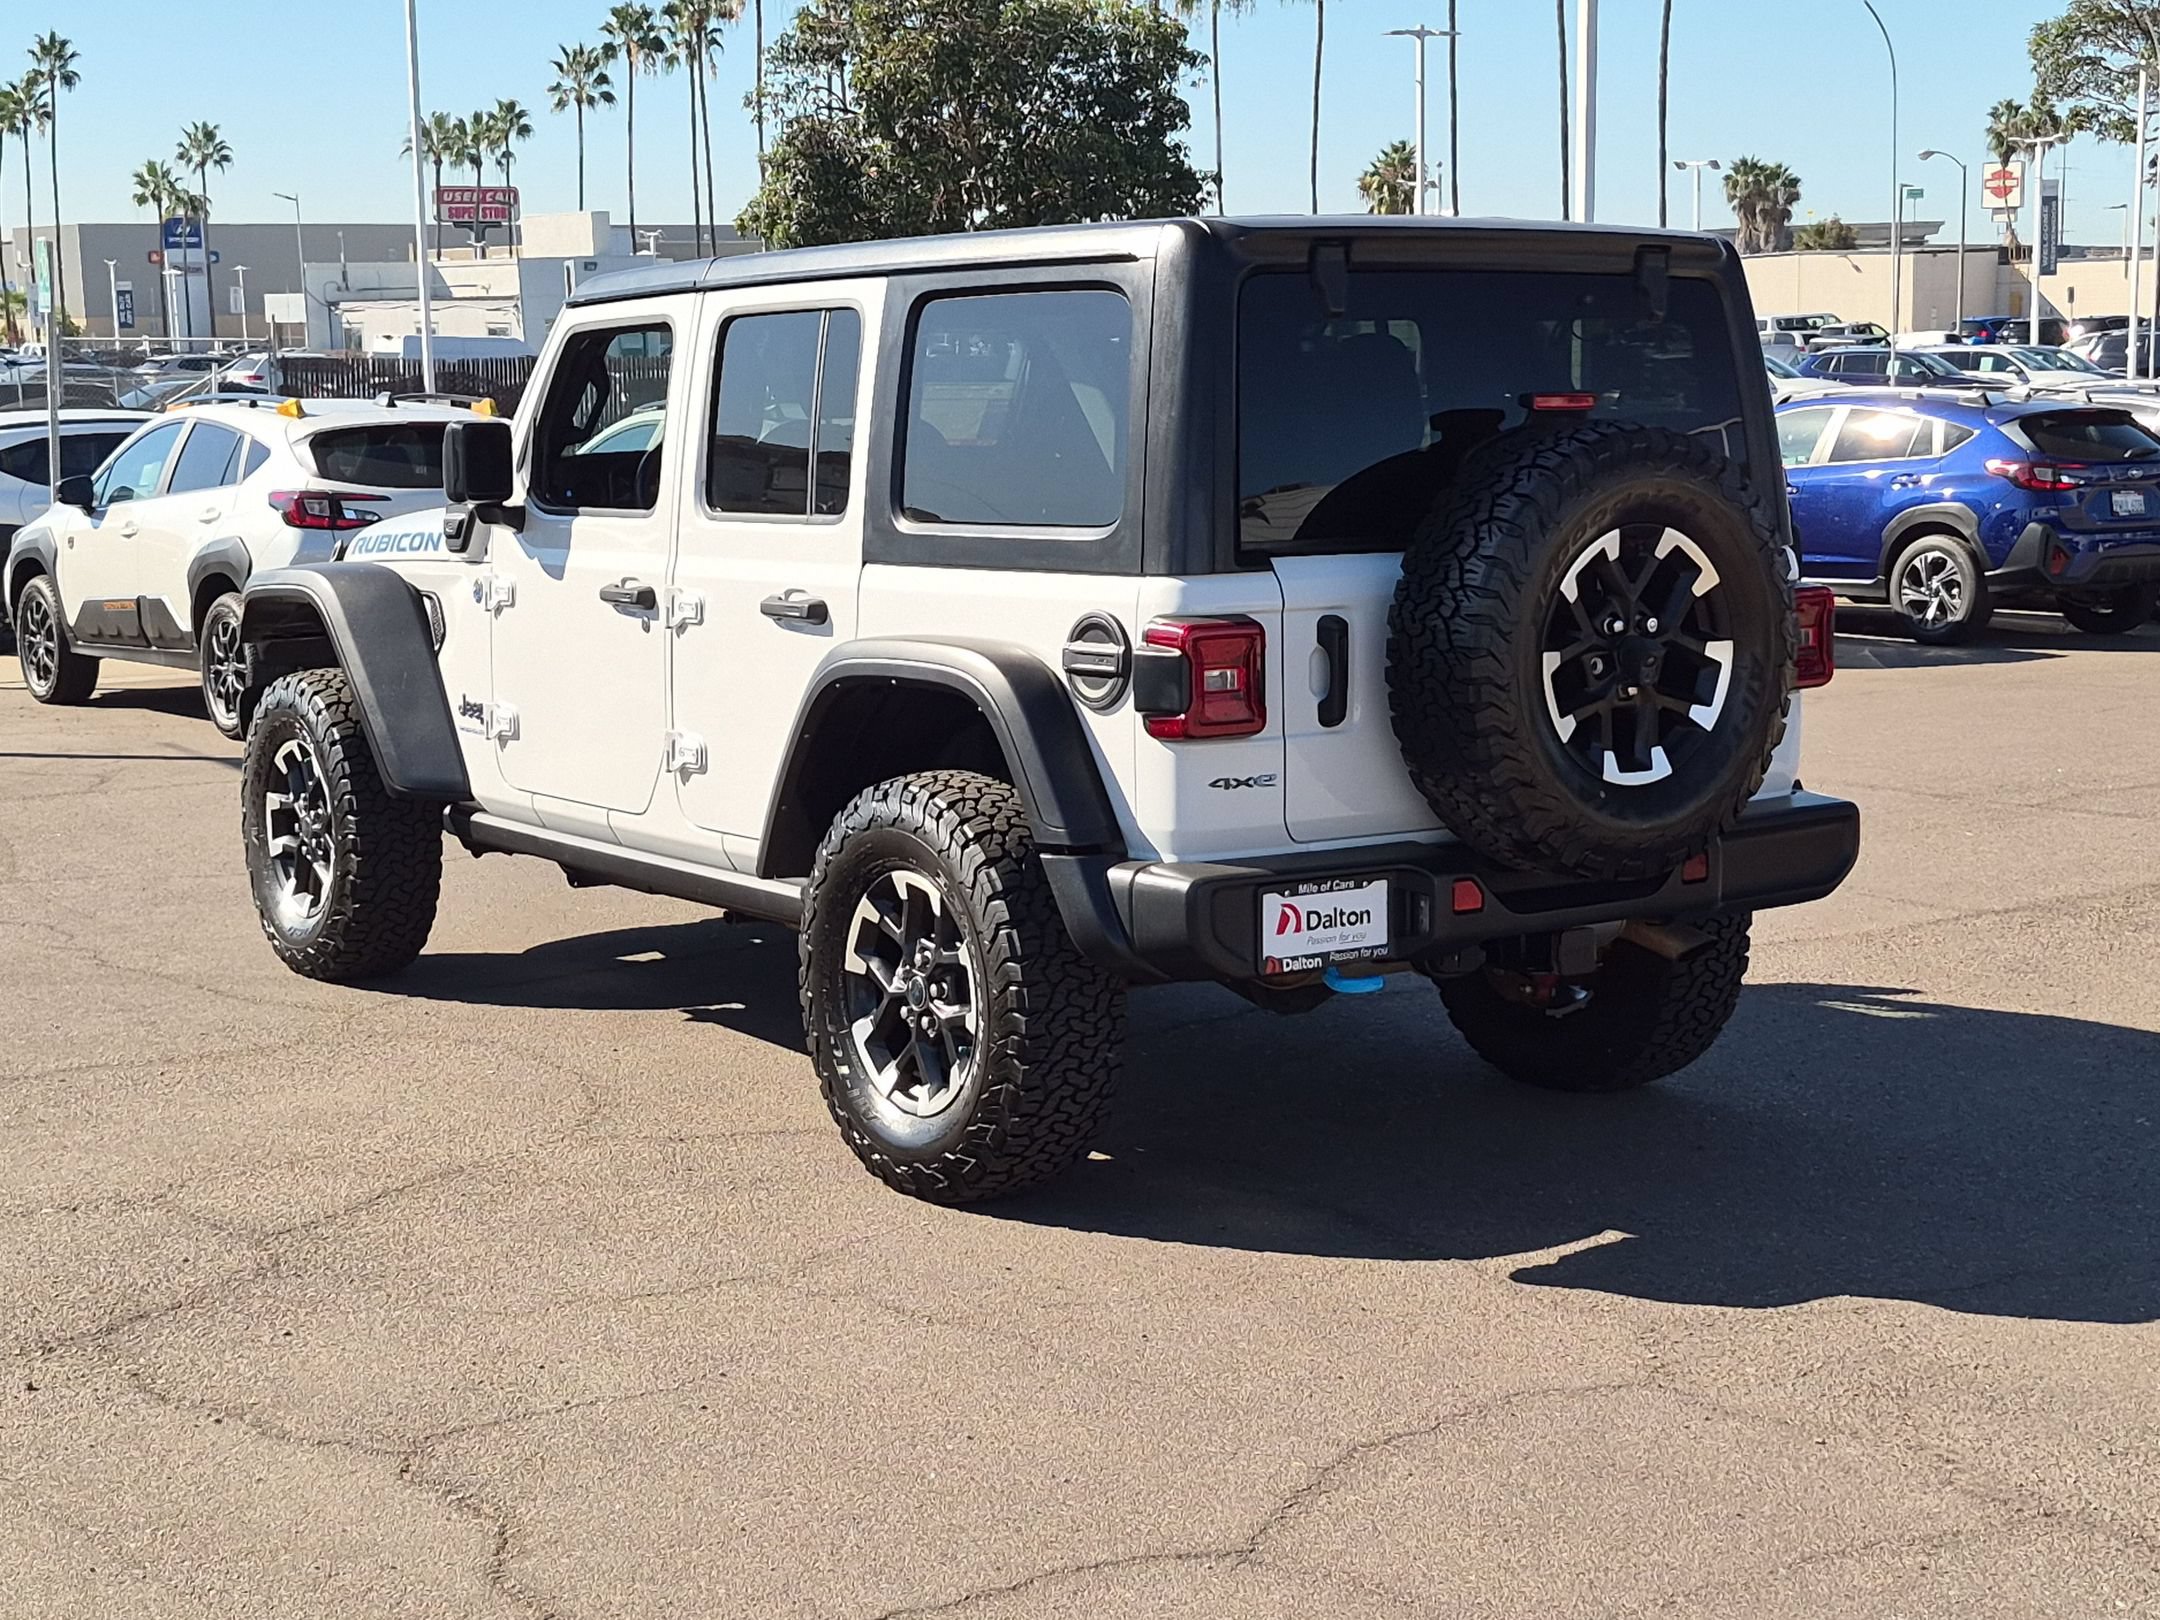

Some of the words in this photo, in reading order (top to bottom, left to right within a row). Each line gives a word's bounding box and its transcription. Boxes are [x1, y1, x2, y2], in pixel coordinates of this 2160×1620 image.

[448, 206, 480, 219] SUPE
[352, 532, 442, 555] RUBICON
[459, 693, 485, 726] Jeep
[1298, 882, 1319, 894] Mile
[1320, 880, 1332, 892] of
[1333, 879, 1355, 891] Cars
[1306, 907, 1371, 932] Dalton
[1307, 934, 1338, 946] Passion
[1339, 931, 1350, 944] for
[1352, 931, 1368, 943] you
[1282, 957, 1322, 973] Dalton
[1329, 950, 1359, 962] Passion
[1360, 948, 1372, 958] for
[1373, 946, 1388, 959] you
